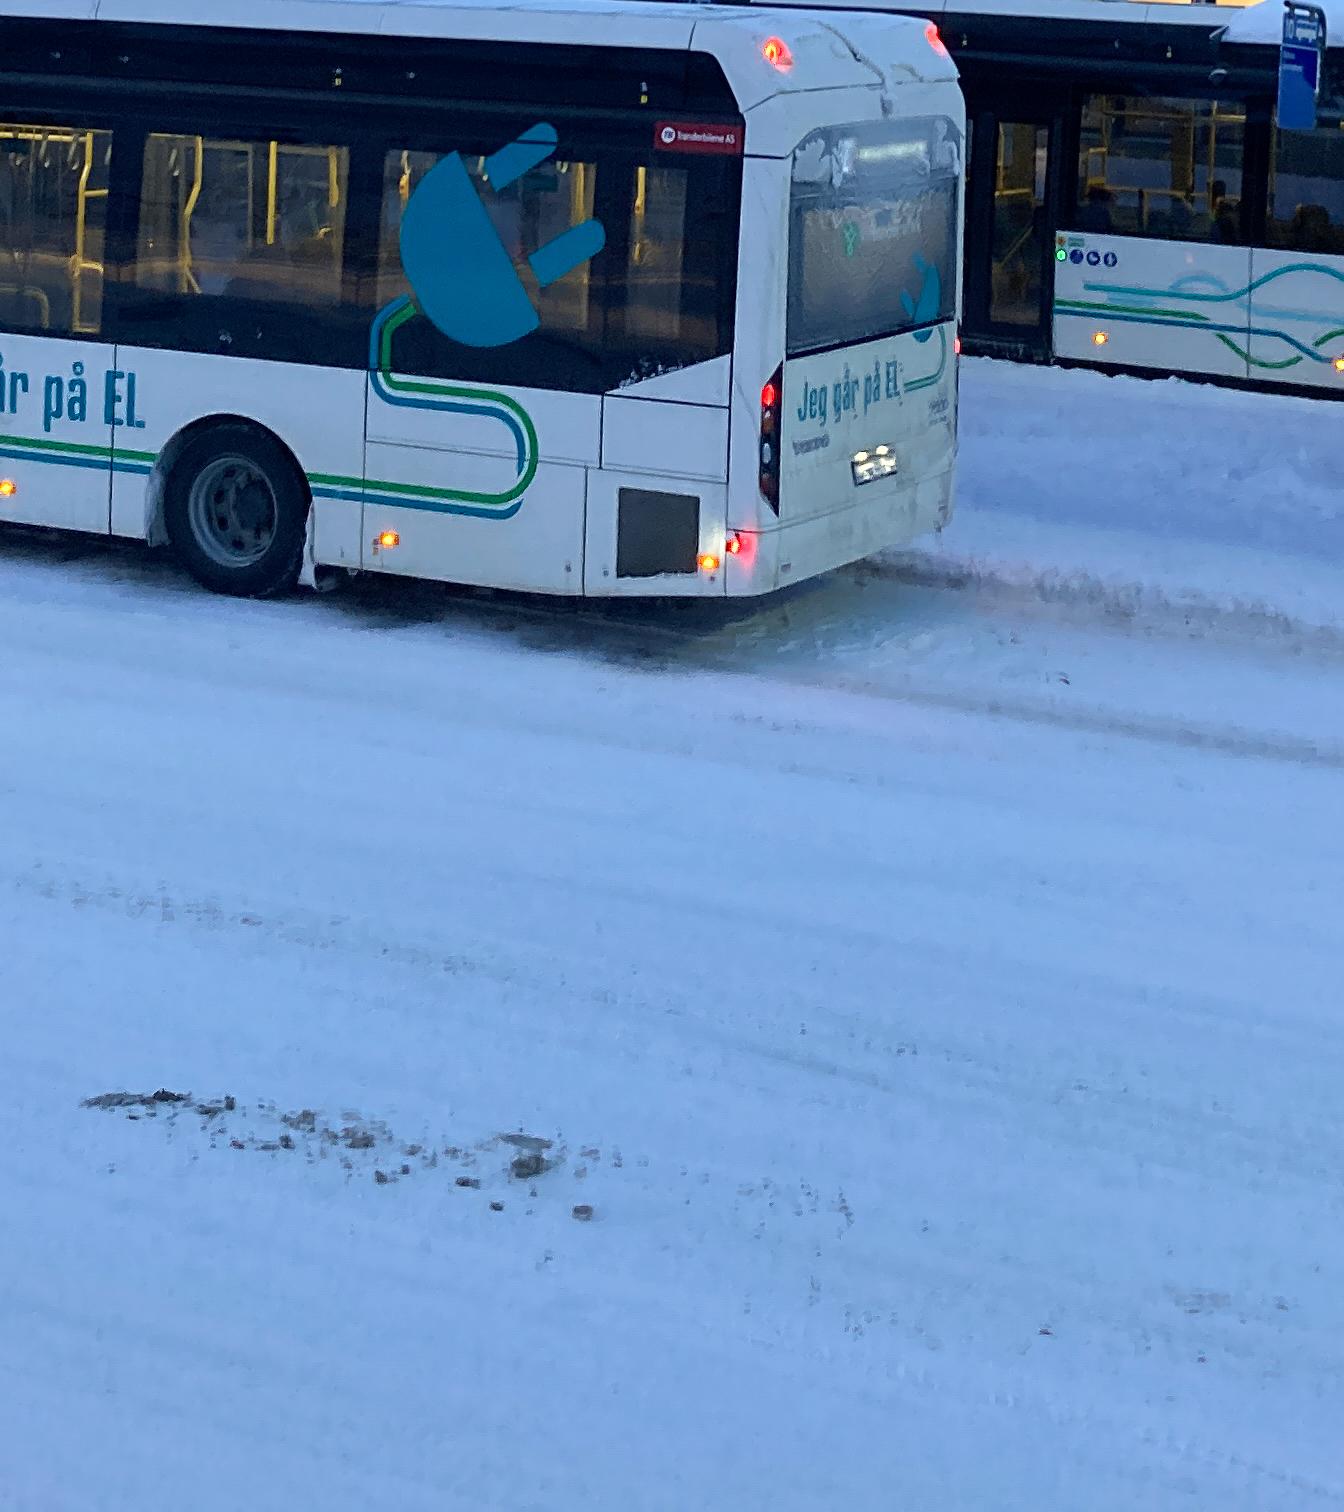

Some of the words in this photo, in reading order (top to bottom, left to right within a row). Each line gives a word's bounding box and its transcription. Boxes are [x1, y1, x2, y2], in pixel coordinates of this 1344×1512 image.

[43, 360, 97, 433] på
[104, 369, 146, 429] EL
[797, 379, 828, 427] Jeg
[832, 361, 860, 424] går
[863, 355, 880, 416] på
